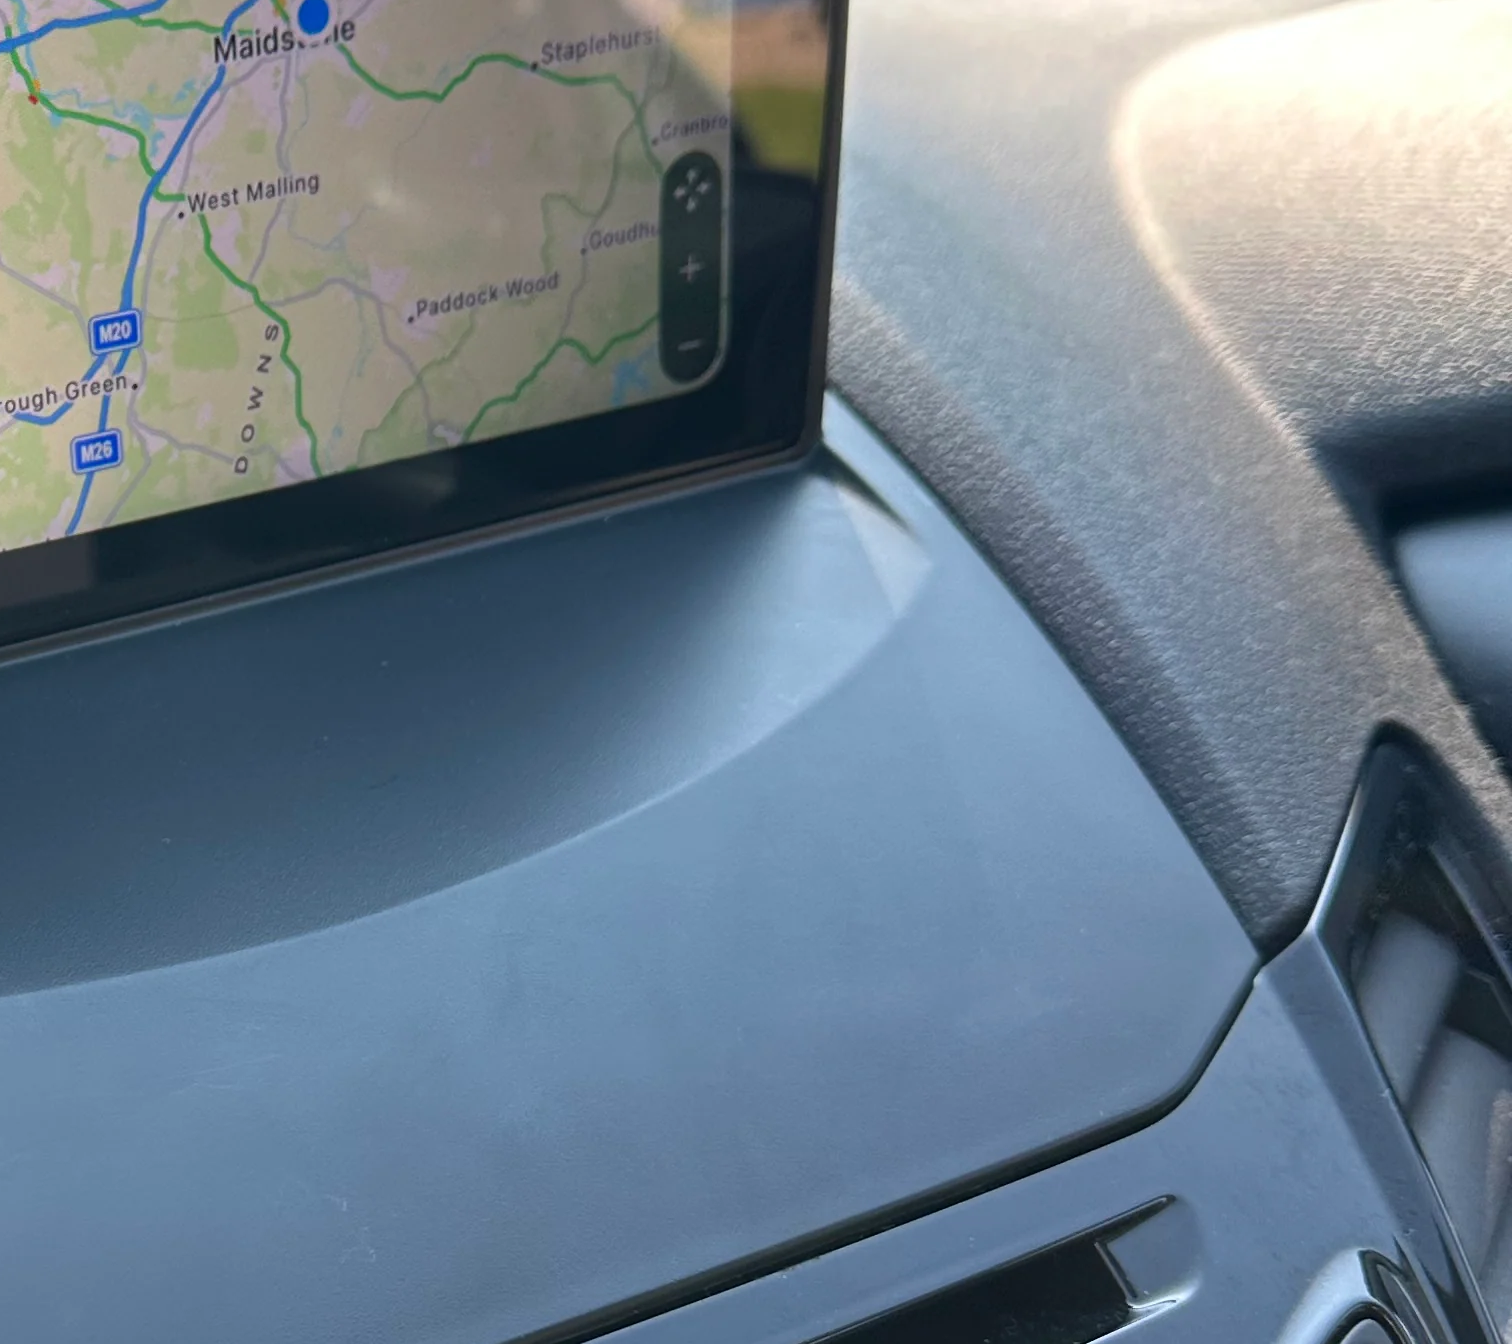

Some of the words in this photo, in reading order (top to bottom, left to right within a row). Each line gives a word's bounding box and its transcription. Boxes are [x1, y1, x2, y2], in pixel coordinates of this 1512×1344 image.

[214, 20, 355, 63] Maidse
[541, 26, 660, 64] Staplehurst
[188, 187, 240, 214] West
[246, 173, 320, 204] Malling
[415, 287, 500, 319] Paddock
[504, 272, 561, 298] Wood
[99, 319, 132, 343] M20
[64, 372, 128, 400] Green
[80, 440, 113, 463] M26
